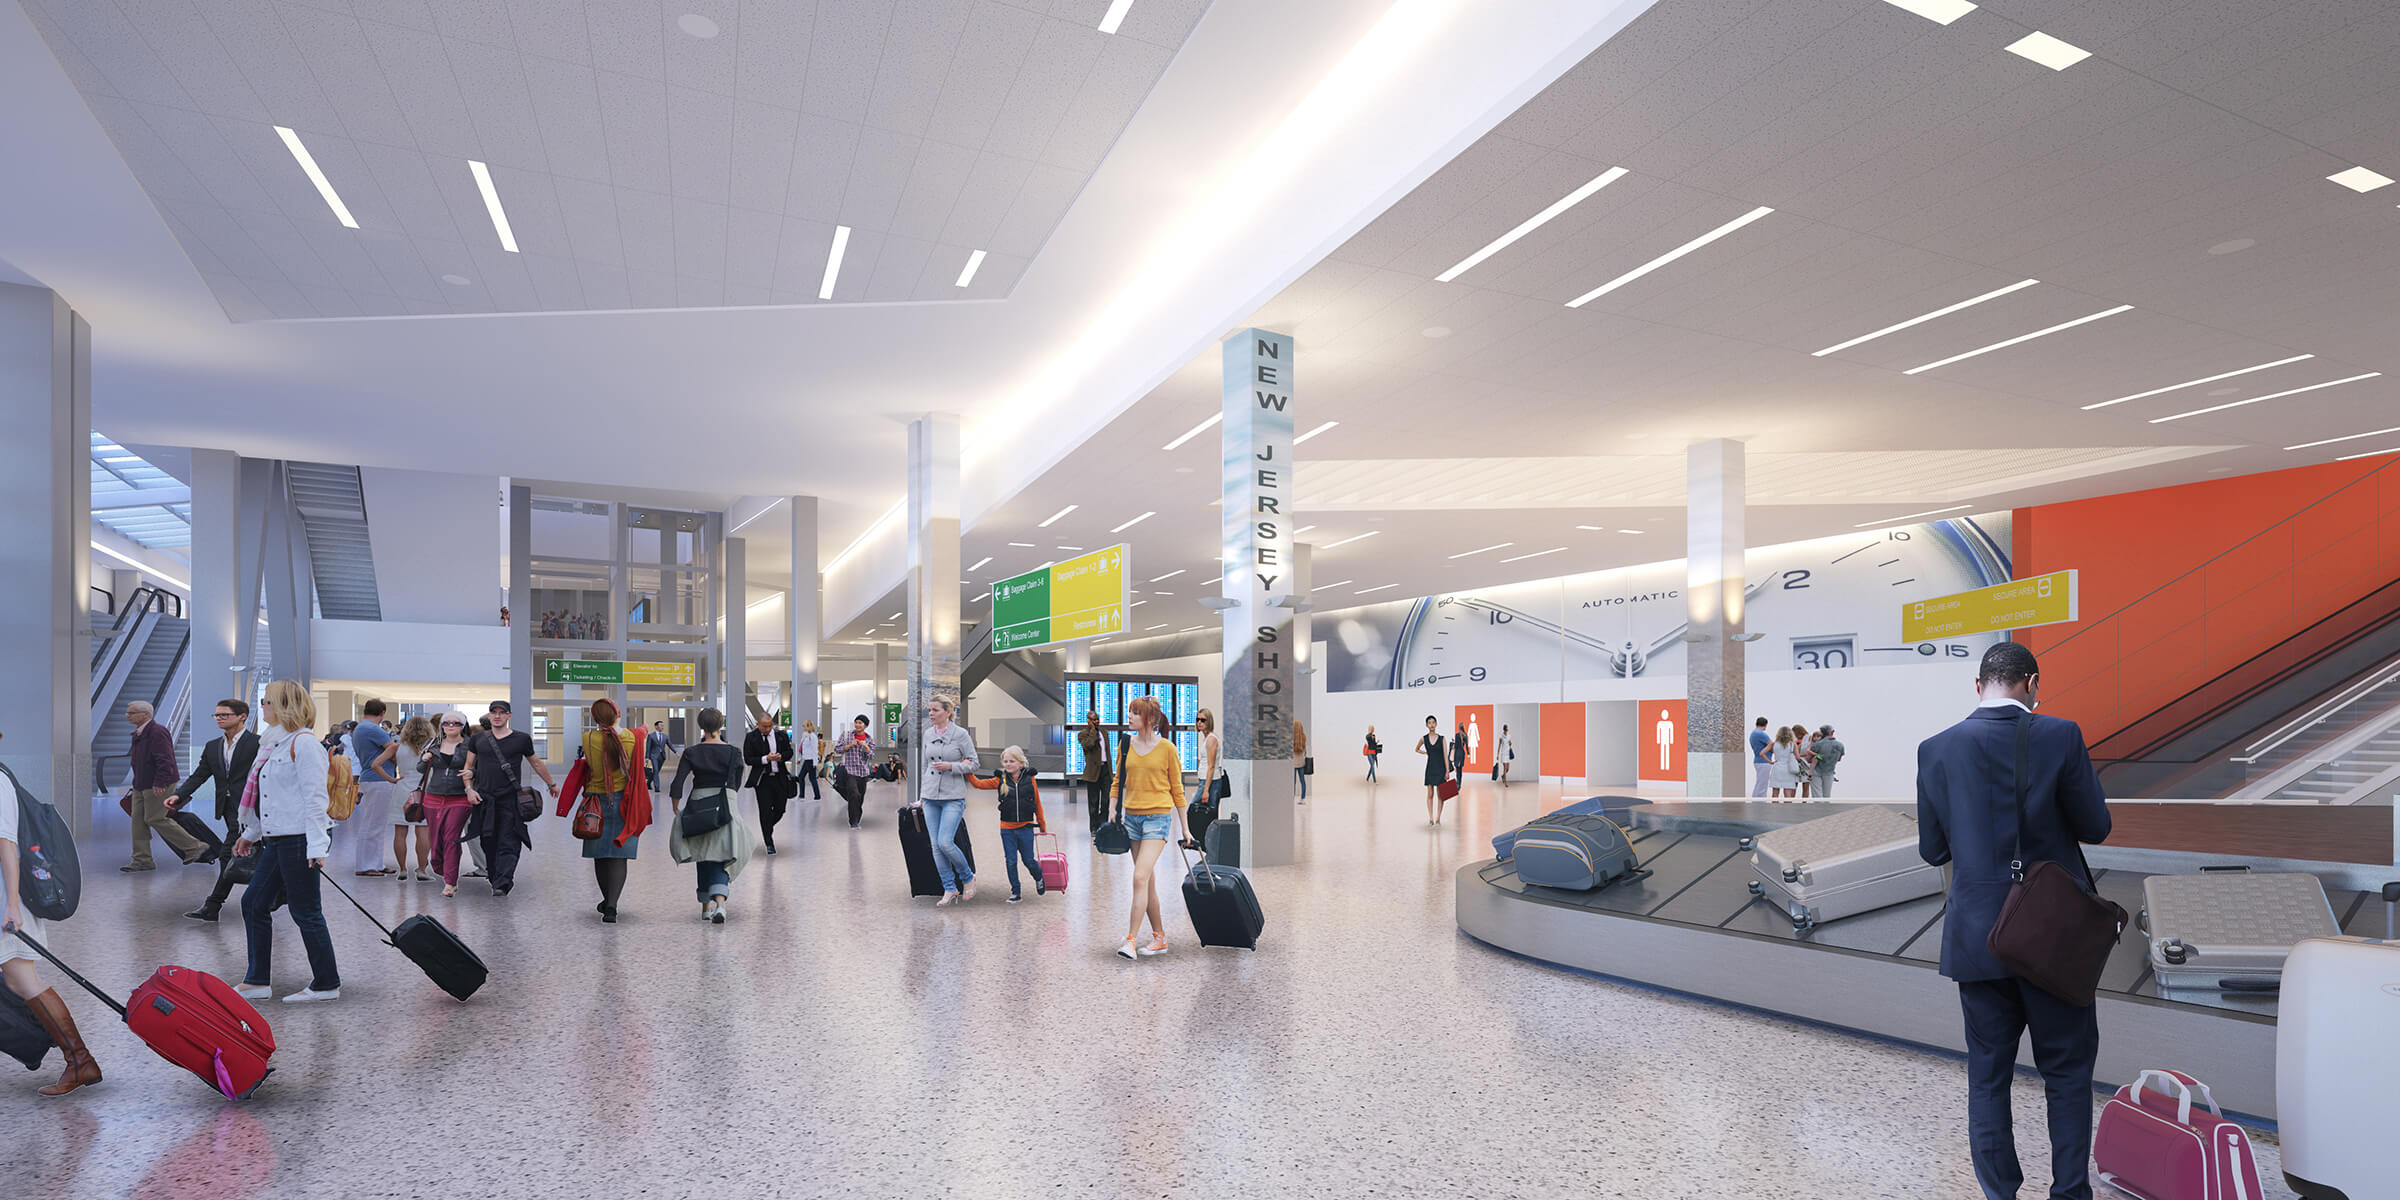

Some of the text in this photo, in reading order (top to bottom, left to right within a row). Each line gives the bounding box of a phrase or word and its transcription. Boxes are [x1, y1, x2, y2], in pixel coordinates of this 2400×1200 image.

[1256, 339, 1287, 747] NEW JERSEY SHORE
[1889, 531, 1911, 542] 10
[1782, 569, 1811, 590] 2
[1011, 584, 1026, 595] Baggage
[1027, 580, 1037, 590] Claim
[1438, 596, 1454, 608] 50
[1992, 589, 2016, 601] SECURE
[1490, 610, 1513, 625] 10
[1990, 609, 2035, 625] DO NOT ENTER
[1945, 644, 1969, 658] 15
[1797, 649, 1848, 670] 30
[1470, 667, 1486, 682] 9
[1408, 677, 1425, 688] 45
[784, 716, 790, 724] 4
[890, 711, 897, 721] 3
